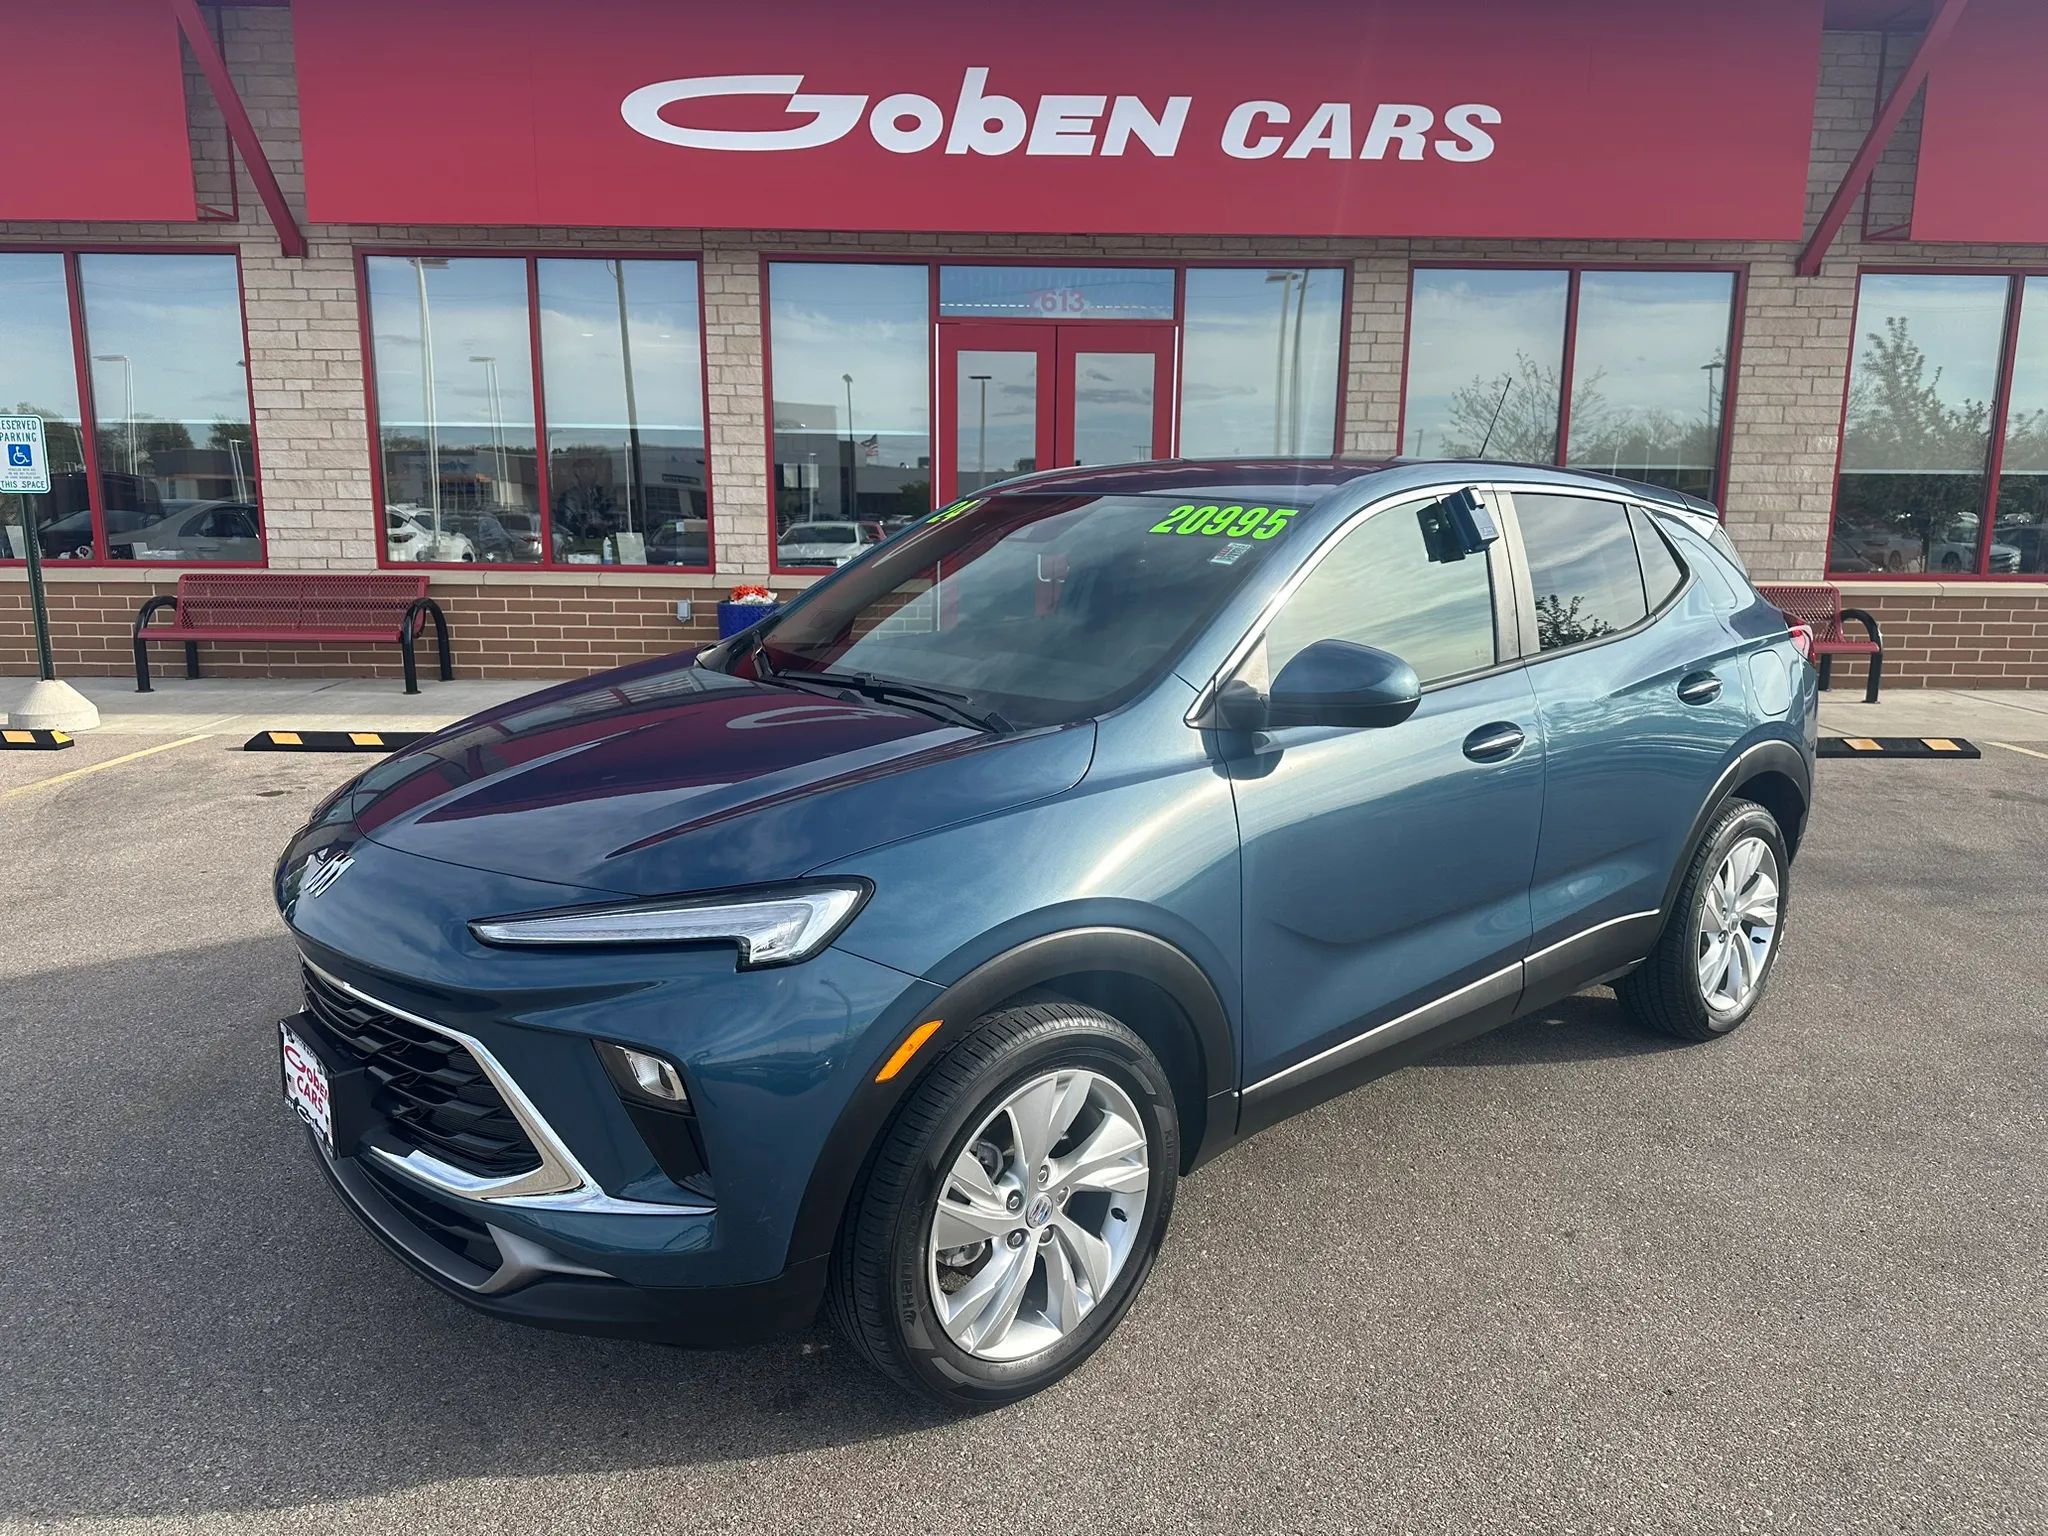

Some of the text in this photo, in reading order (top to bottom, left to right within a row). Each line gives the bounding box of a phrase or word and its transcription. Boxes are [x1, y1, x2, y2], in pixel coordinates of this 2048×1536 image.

[1220, 101, 1502, 163] CARS
[0, 420, 37, 430] ESERVED
[1, 480, 46, 489] THIS SPACE
[1149, 504, 1298, 540] 20995
[296, 1075, 324, 1115] CARS
